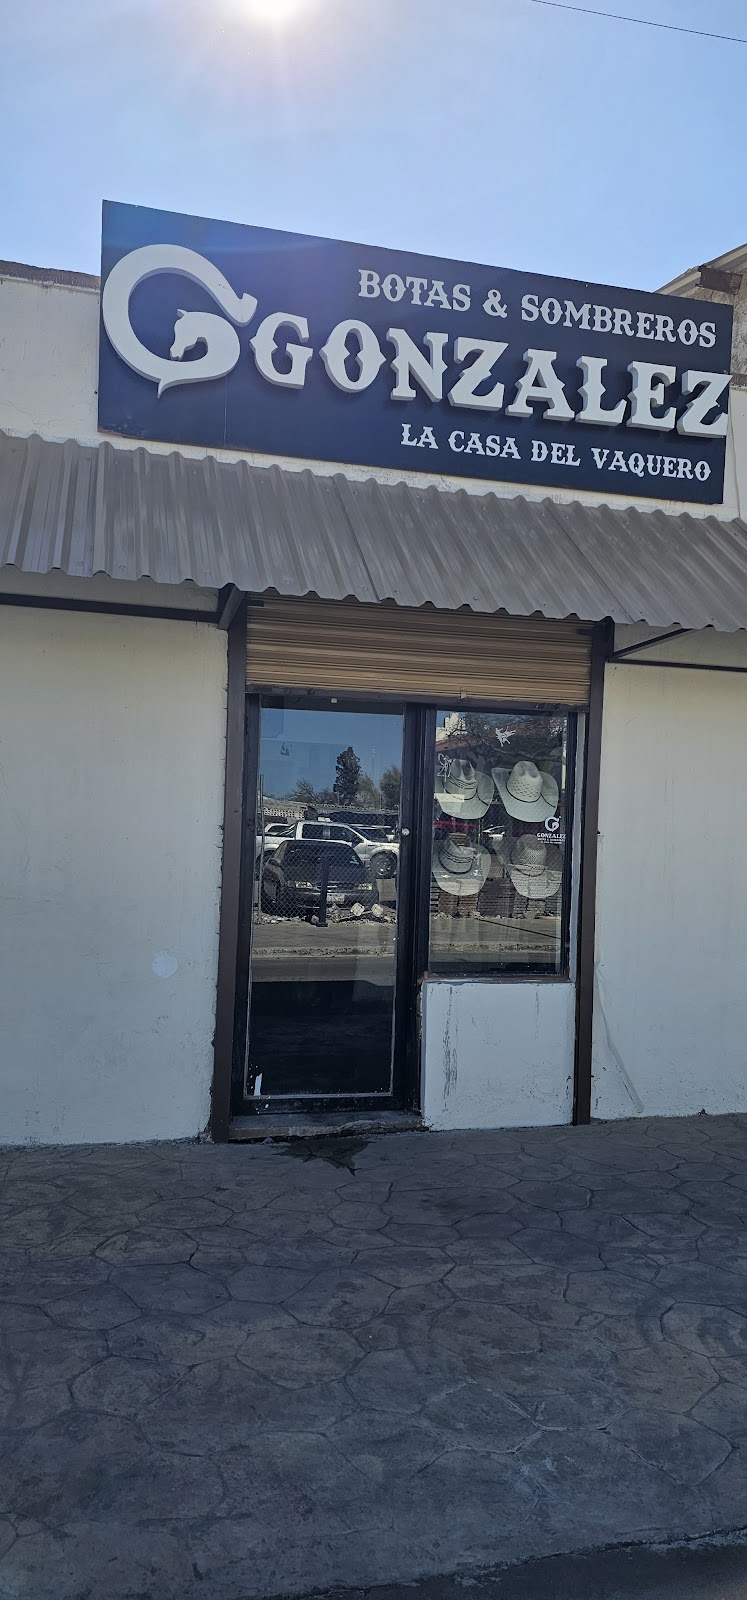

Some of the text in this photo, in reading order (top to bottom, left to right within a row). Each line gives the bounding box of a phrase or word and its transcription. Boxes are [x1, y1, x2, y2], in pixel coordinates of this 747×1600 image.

[357, 268, 717, 348] BOTAS & SOMBREROS
[249, 311, 732, 438] GONZALEZ
[400, 423, 712, 482] LA CASA DEL VAQUERO
